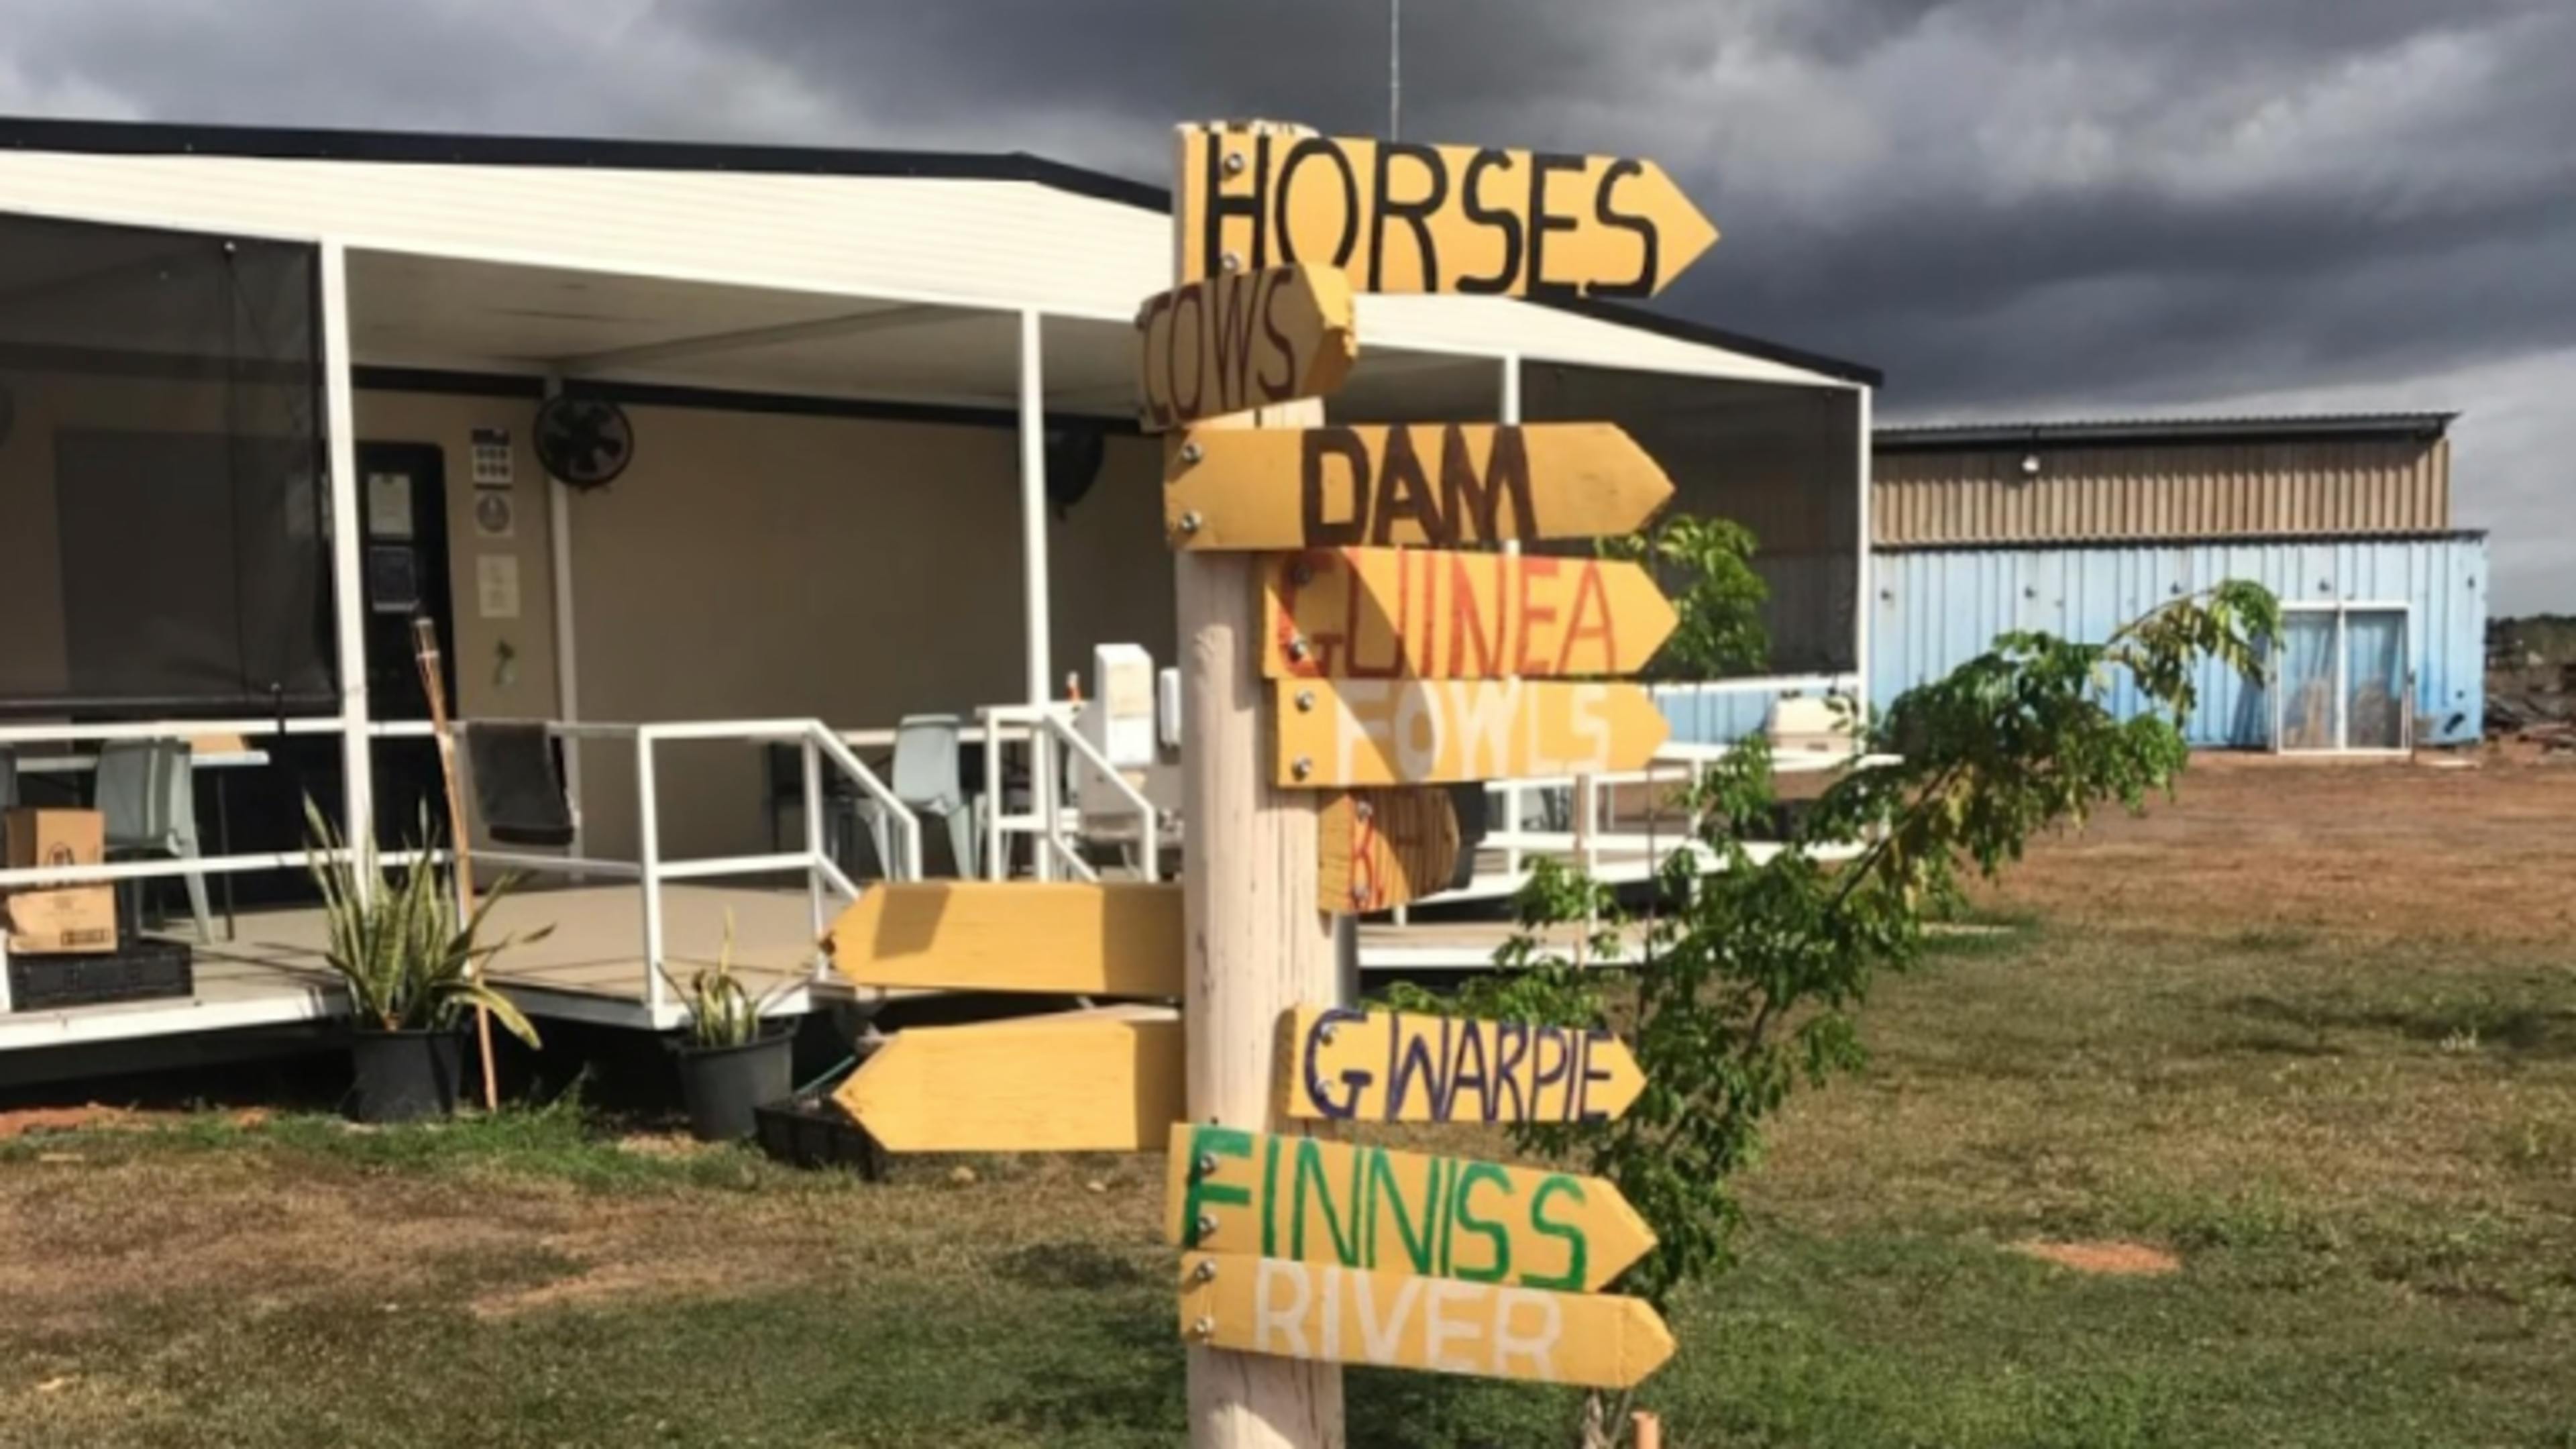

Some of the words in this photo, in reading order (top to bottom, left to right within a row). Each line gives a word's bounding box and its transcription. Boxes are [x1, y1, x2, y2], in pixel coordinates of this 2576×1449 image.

[1203, 132, 1659, 299] HORSES
[1138, 268, 1295, 425] COWS
[1301, 425, 1538, 547] DAM
[1278, 547, 1617, 679] GUINEA
[1335, 676, 1611, 786] FOWLS
[1183, 1125, 1587, 1292] FINNISS
[1254, 1256, 1562, 1381] RIVER
